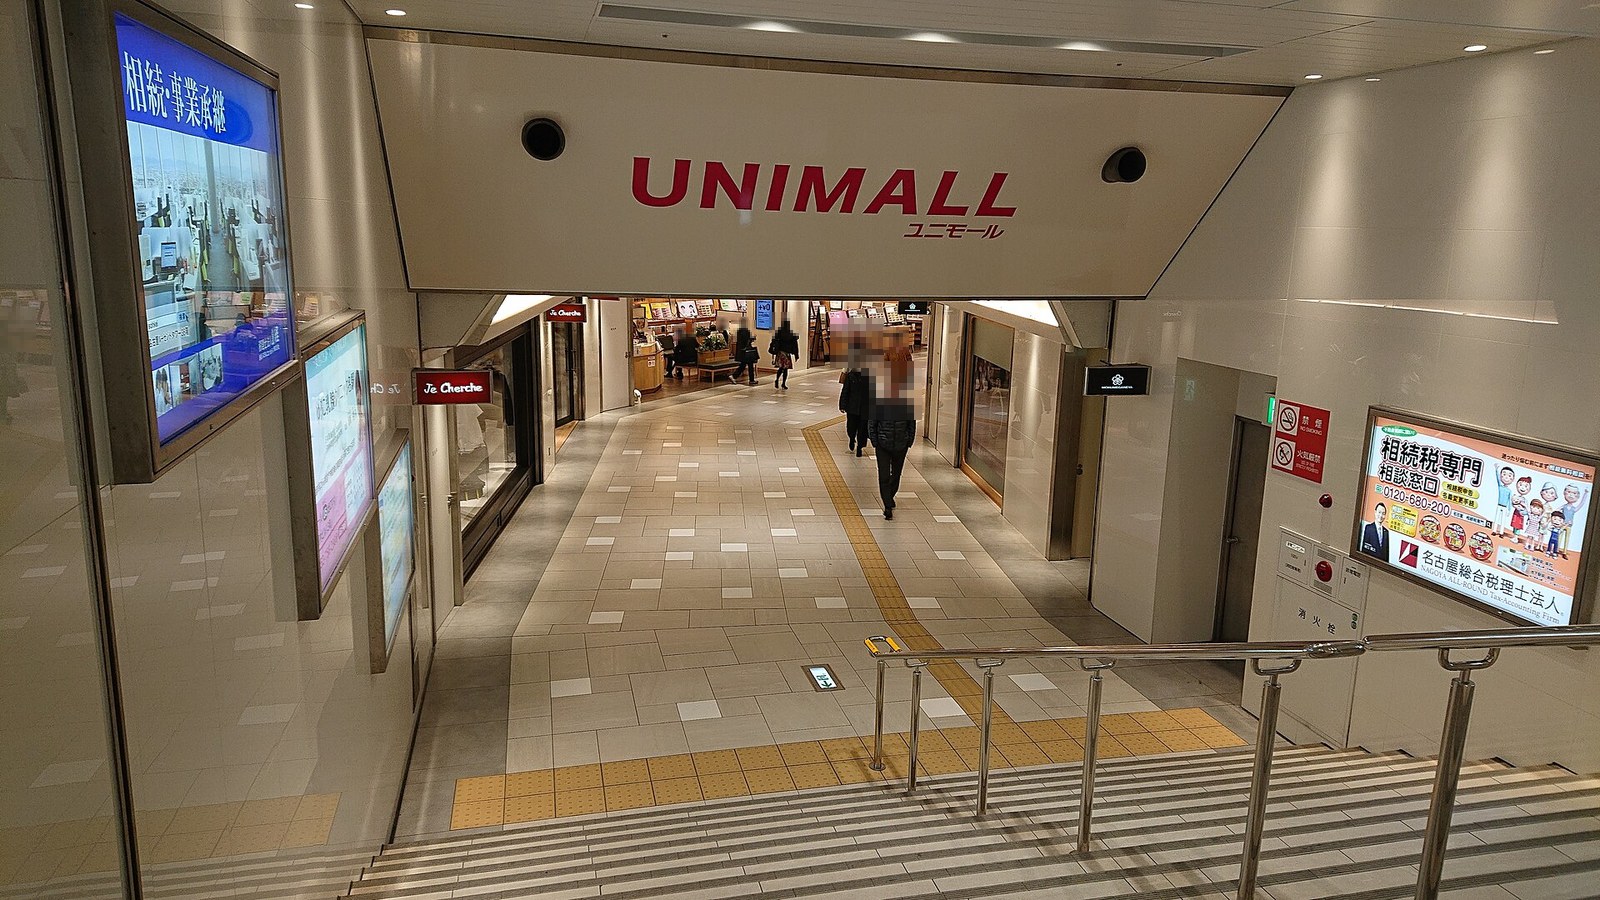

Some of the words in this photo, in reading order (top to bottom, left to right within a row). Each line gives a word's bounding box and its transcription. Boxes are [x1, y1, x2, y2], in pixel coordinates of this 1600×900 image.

[123, 51, 226, 133] 相続・事業承継
[631, 156, 1017, 218] UNIMALL
[903, 222, 1005, 240] ユニモール
[423, 382, 438, 394] Je
[440, 381, 483, 394] Cherche
[1379, 463, 1438, 495] 相談窓口
[1381, 436, 1482, 485] 相続税専門
[1384, 486, 1450, 516] 0120-680-200
[1421, 564, 1447, 580] NAGOYA
[1449, 575, 1488, 596] ALL-ROUND
[1542, 611, 1560, 624] Firm
[1422, 550, 1560, 614] 名古屋総合税理士法人
